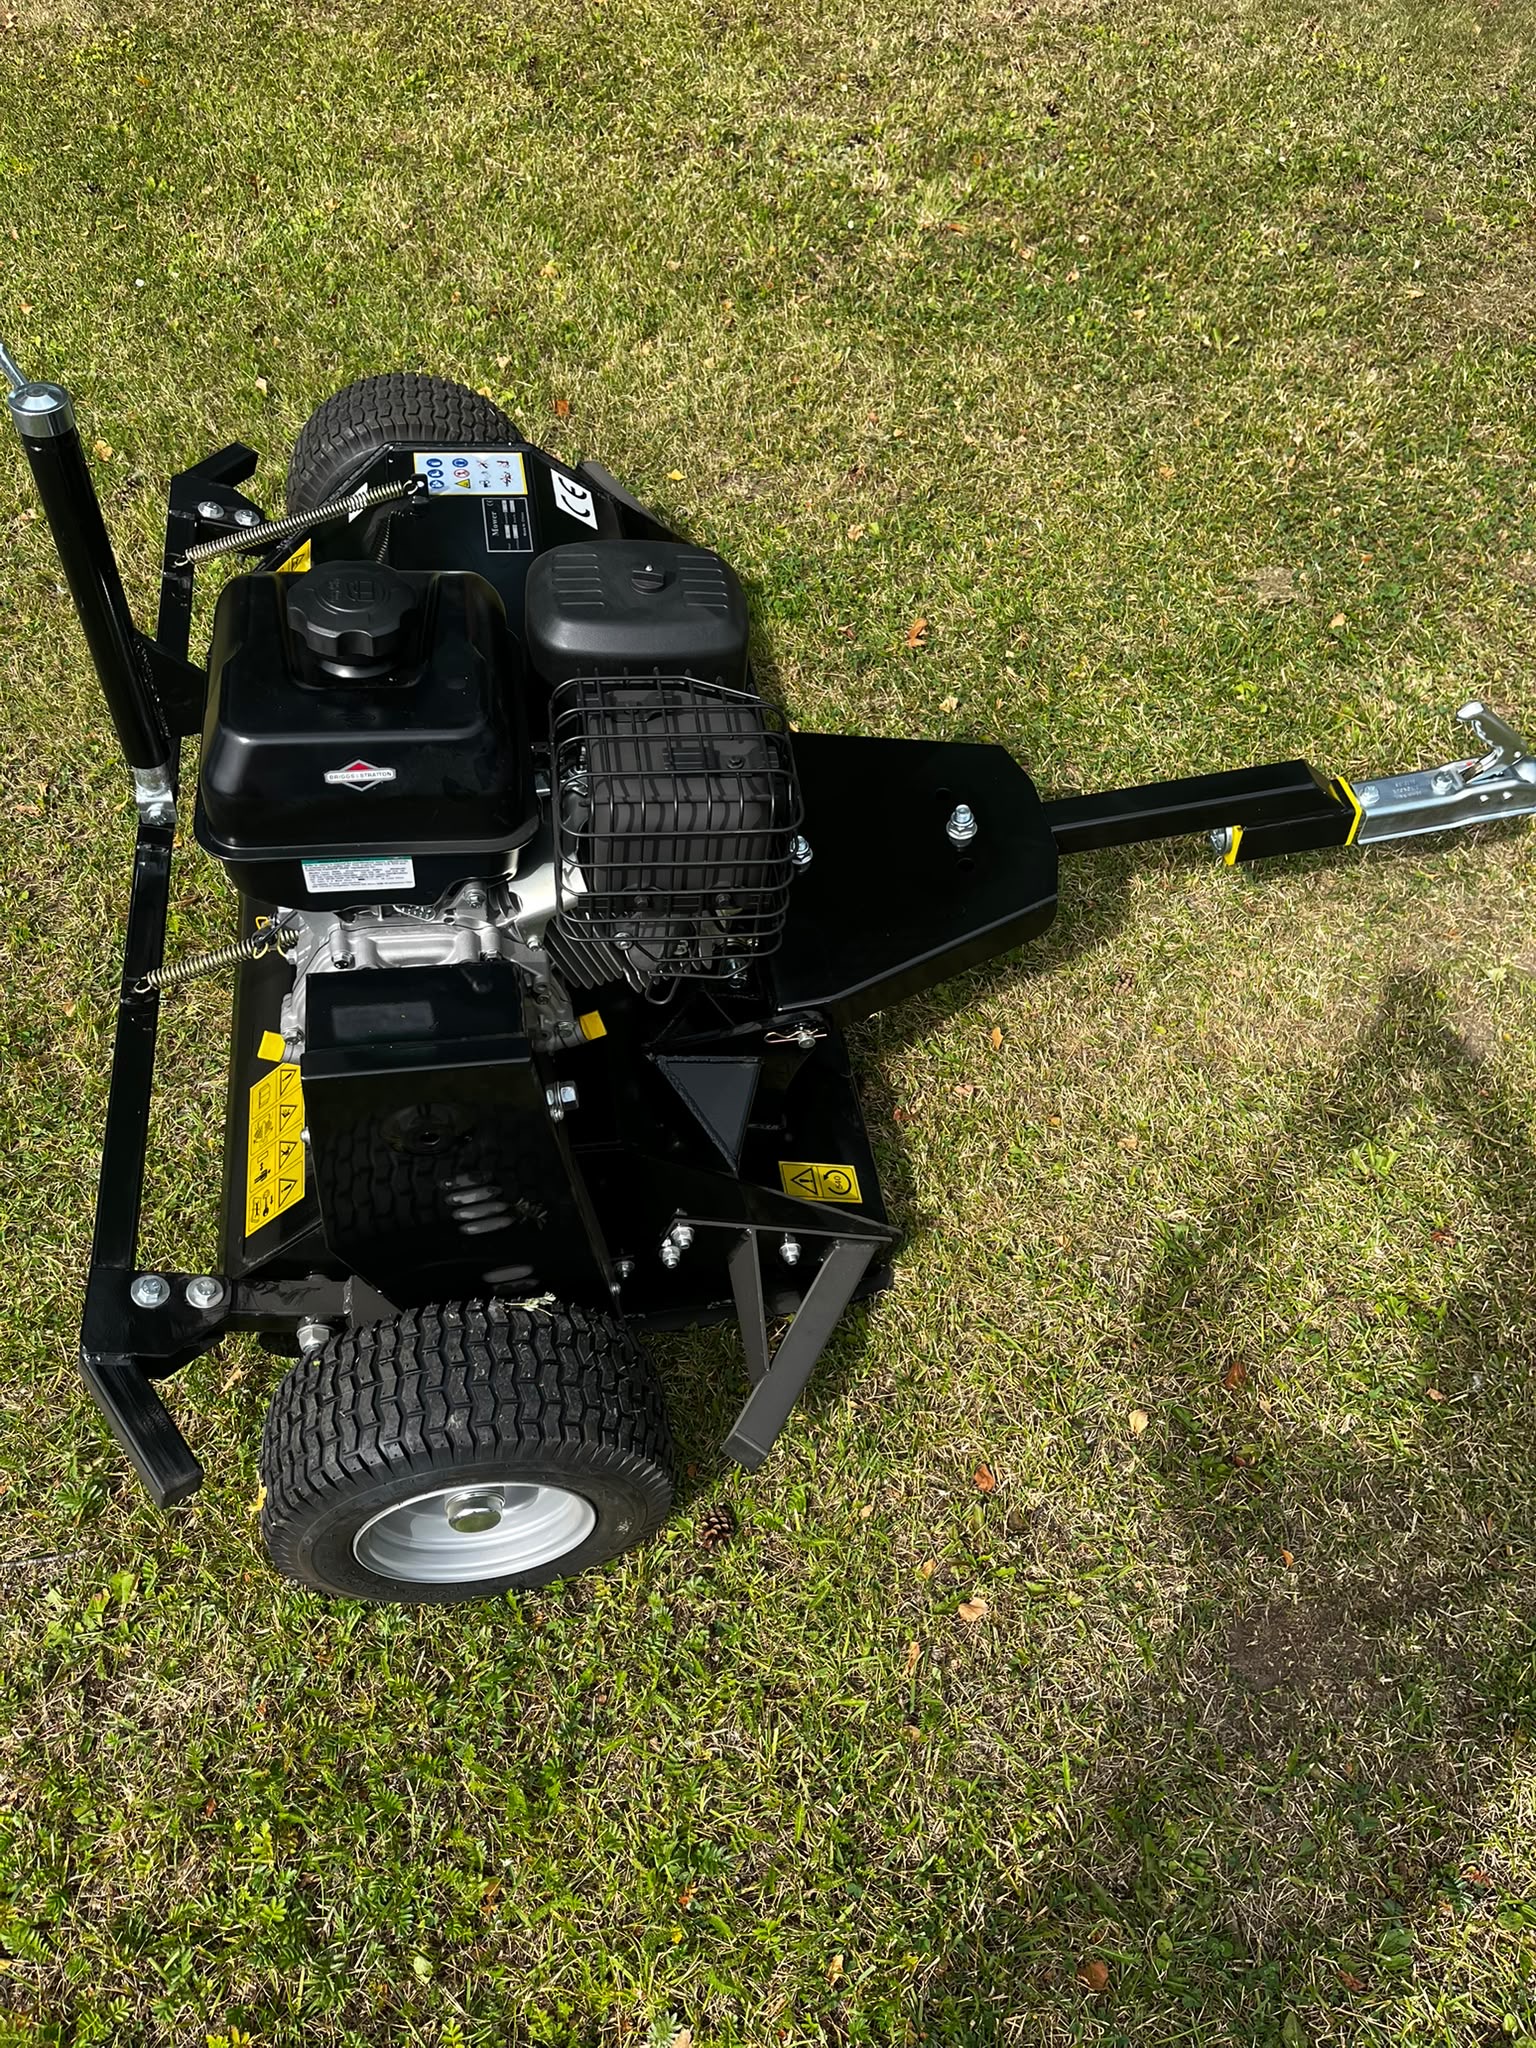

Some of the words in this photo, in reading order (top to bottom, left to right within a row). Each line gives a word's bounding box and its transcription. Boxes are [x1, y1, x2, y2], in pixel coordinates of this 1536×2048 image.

[558, 476, 591, 518] CE
[491, 511, 500, 536] Mower
[360, 771, 392, 779] STRATTON
